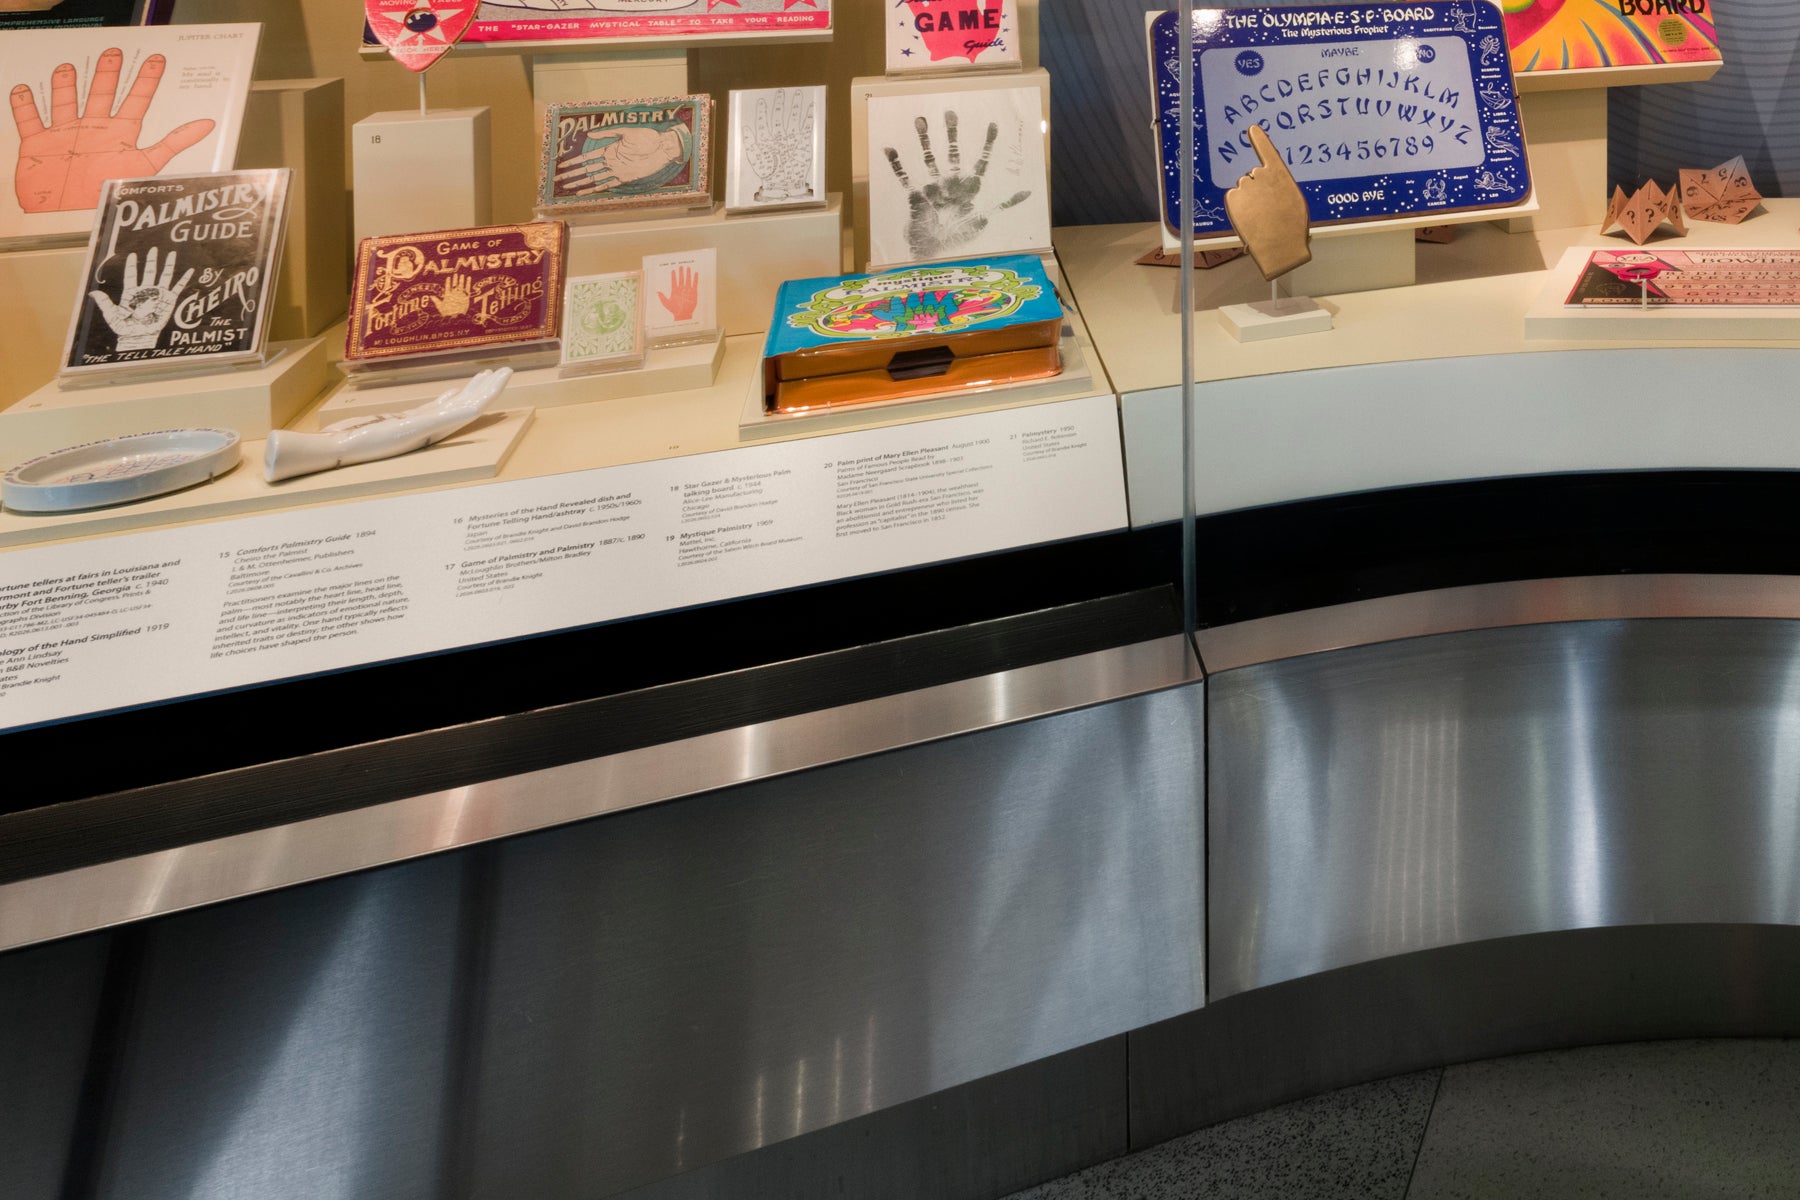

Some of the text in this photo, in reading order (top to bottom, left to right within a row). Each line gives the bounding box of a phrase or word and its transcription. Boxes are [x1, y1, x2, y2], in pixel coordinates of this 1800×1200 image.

[914, 8, 1000, 33] GAME
[1226, 14, 1258, 29] THE
[1281, 24, 1389, 39] The Mysterious Prophet
[1321, 47, 1360, 58] MAYBE
[1238, 58, 1261, 69] YES
[556, 103, 686, 150] PALMISTRY
[369, 134, 382, 144] 18
[1327, 189, 1385, 205] GOOD BYE
[170, 219, 253, 242] GUIDE
[373, 245, 546, 292] PALMISTRY
[173, 266, 260, 329] CHEIRO
[169, 327, 248, 346] PALMIST
[116, 350, 149, 361] TELL
[151, 347, 184, 358] TALE
[679, 528, 716, 540] Mystique
[716, 523, 752, 533] Palmistry
